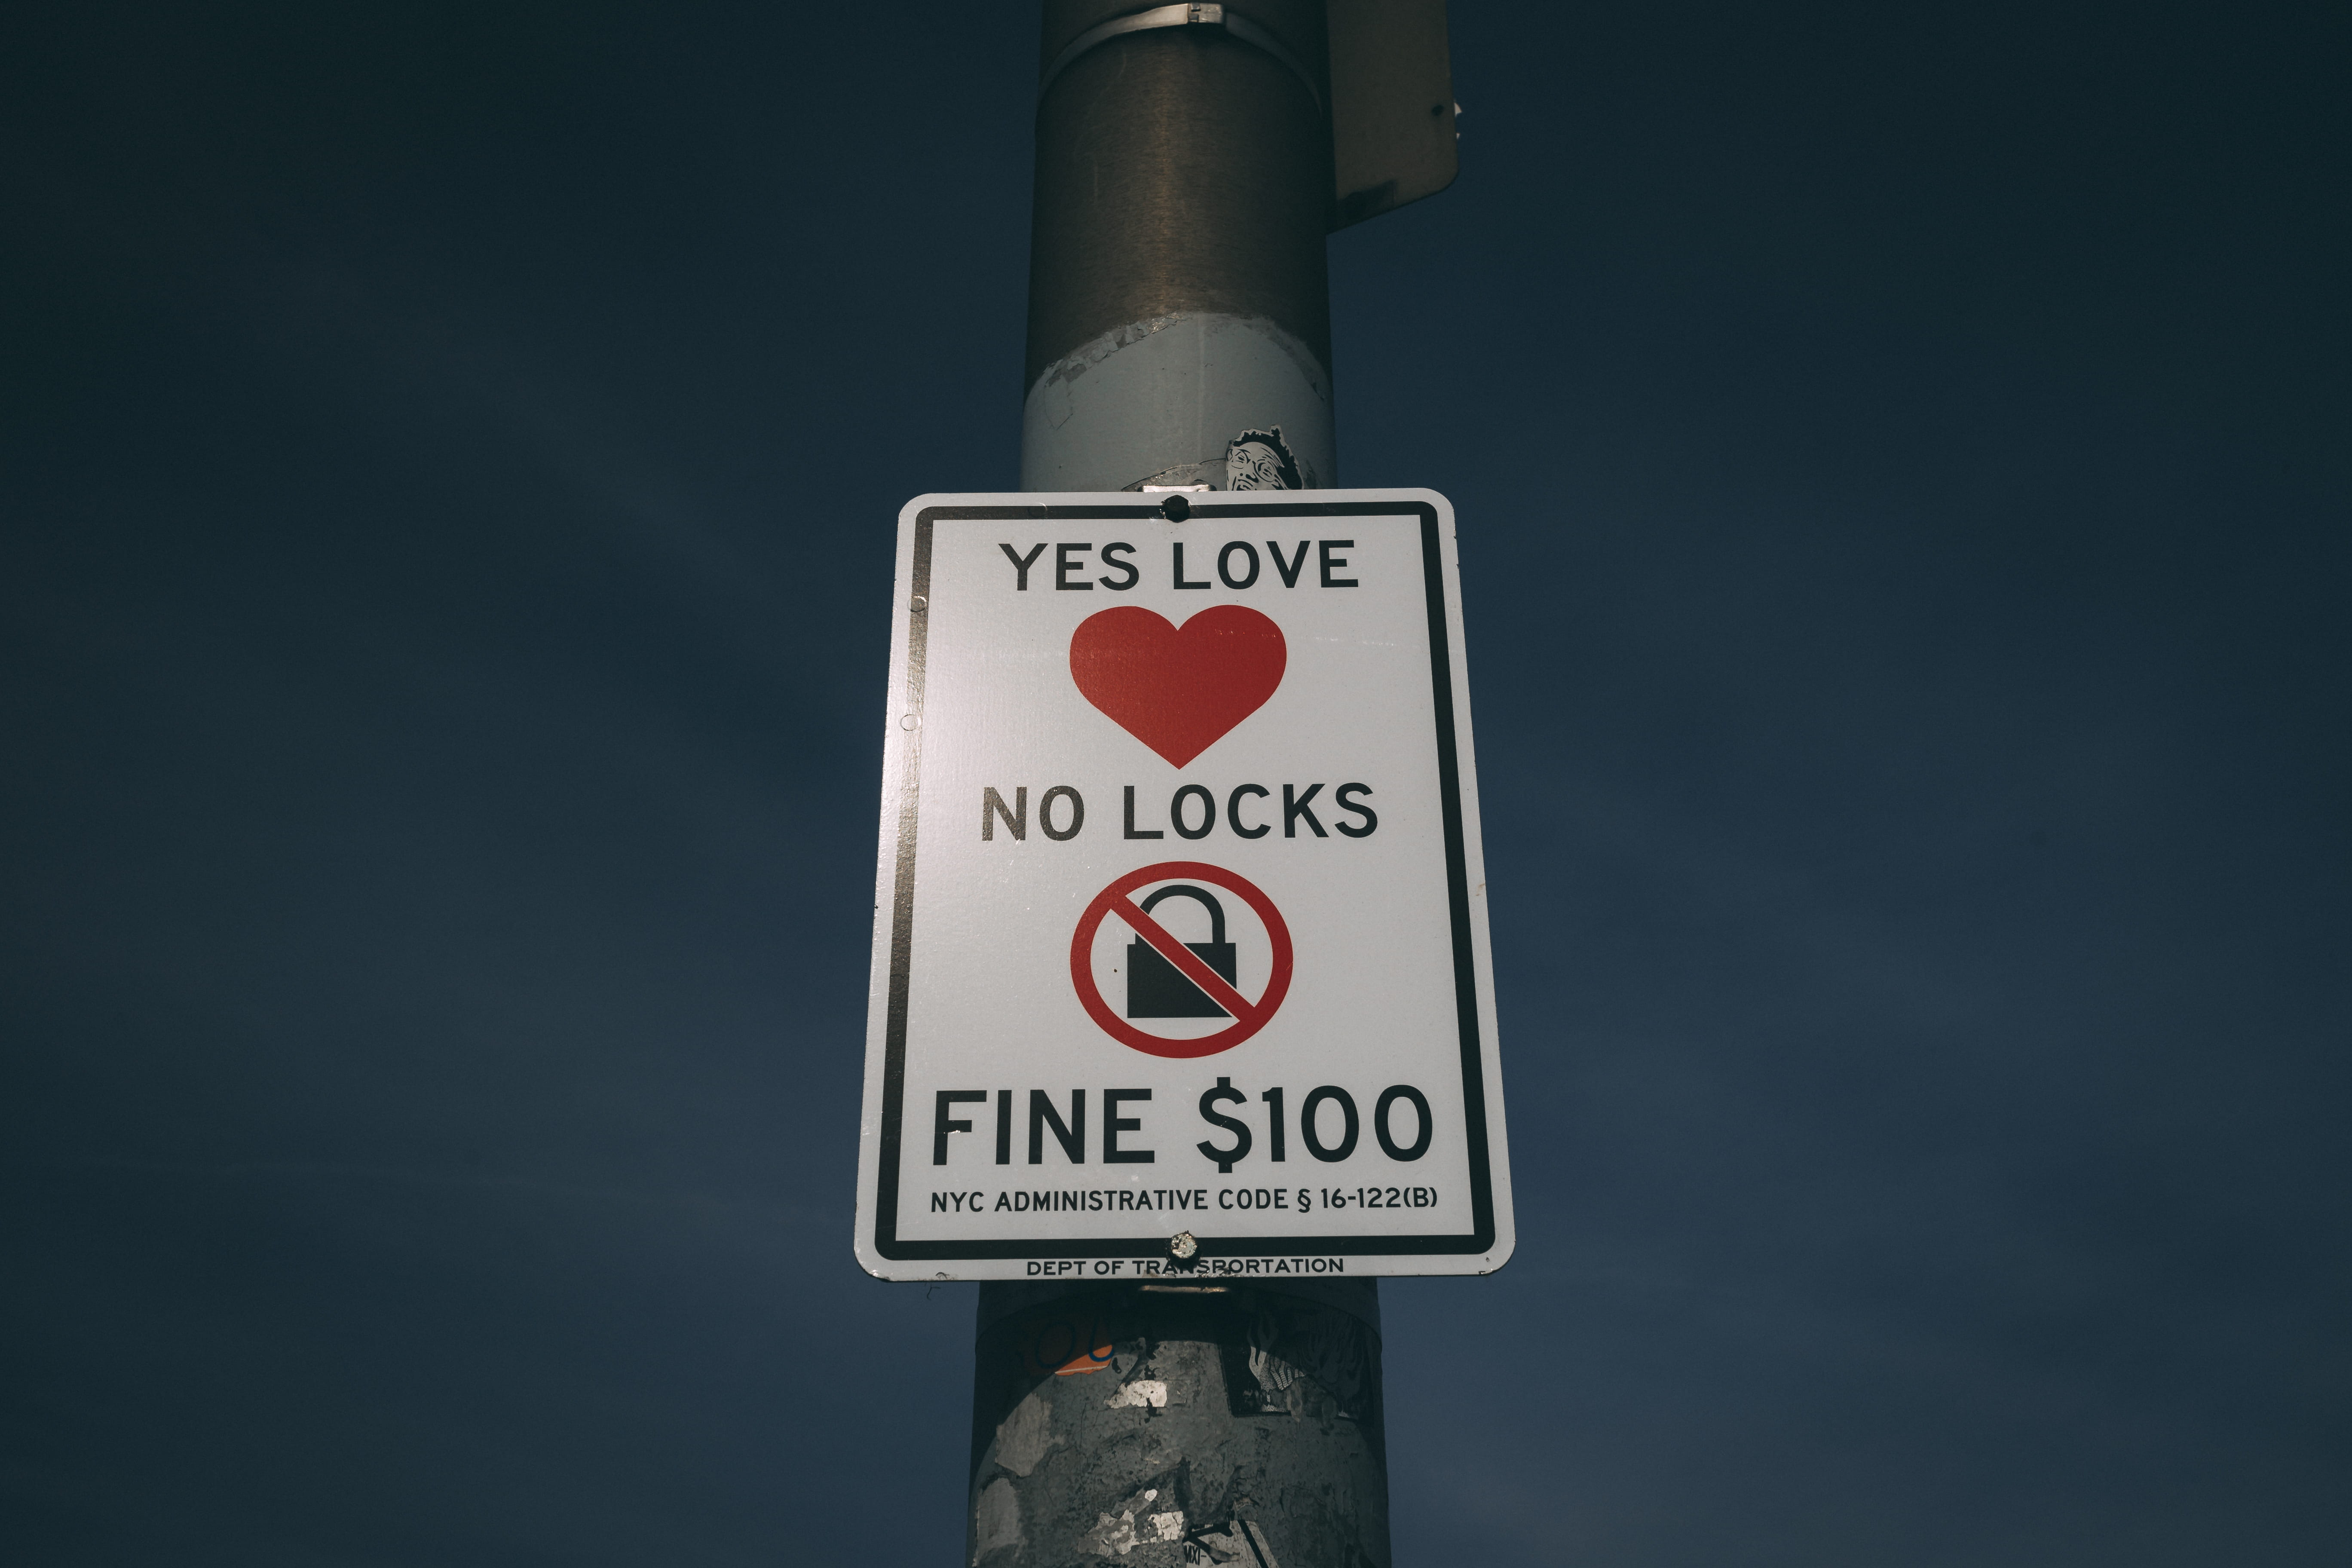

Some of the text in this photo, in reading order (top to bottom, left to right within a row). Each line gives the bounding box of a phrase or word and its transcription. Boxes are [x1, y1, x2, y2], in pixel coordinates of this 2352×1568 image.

[998, 540, 1358, 591] YES LOVE
[982, 783, 1378, 841] NO LOCKS
[933, 1077, 1432, 1173] FINE $100
[931, 1187, 1437, 1213] NYC ADMINISTRATIVE CODE § 16-122(B)
[1027, 1261, 1086, 1275] DEPT
[1094, 1261, 1124, 1275] OF
